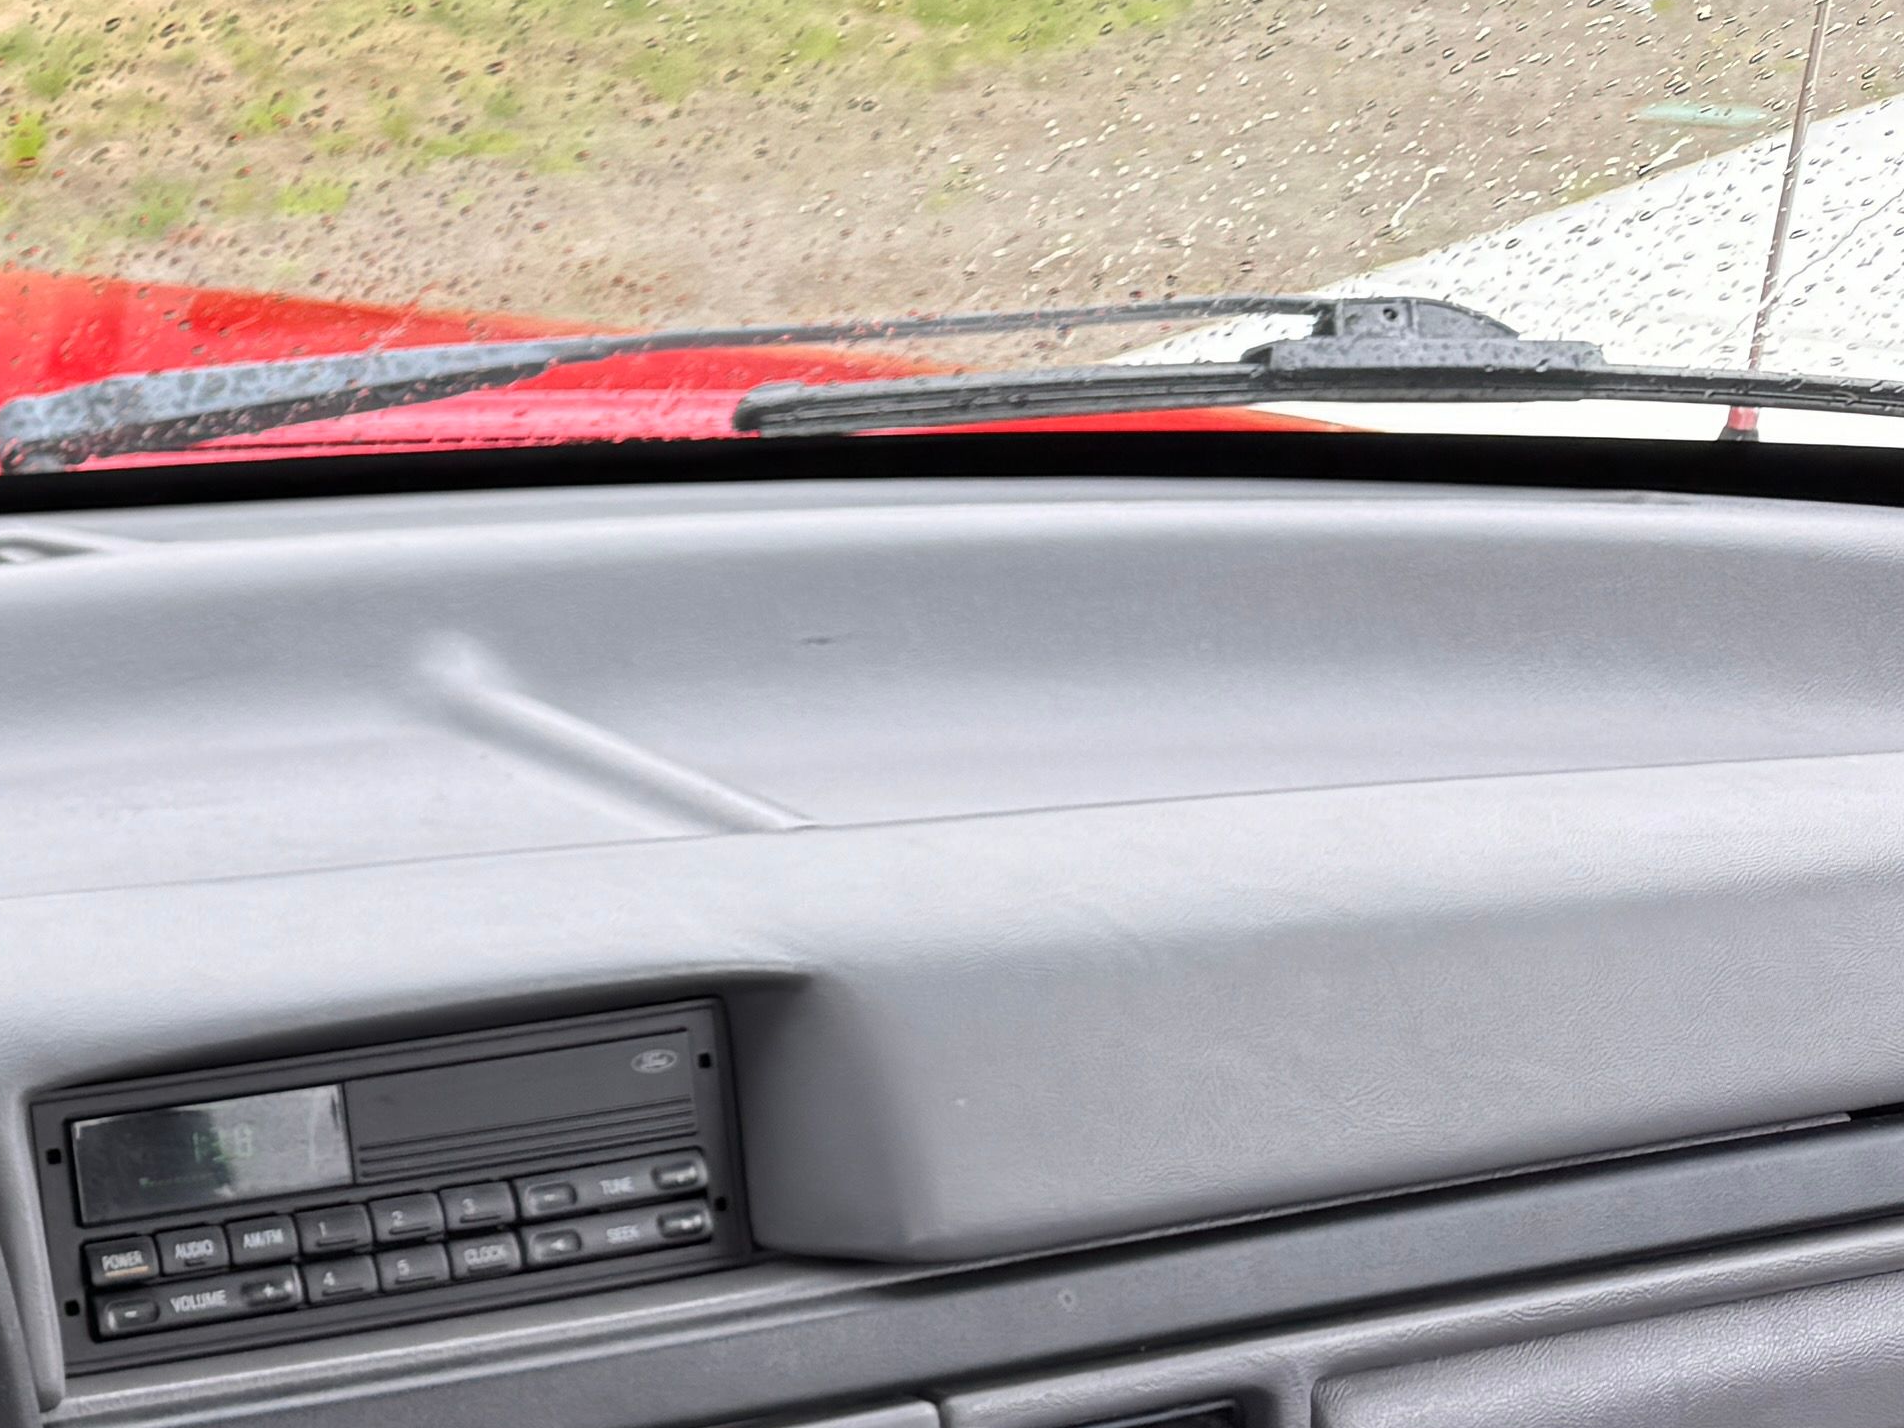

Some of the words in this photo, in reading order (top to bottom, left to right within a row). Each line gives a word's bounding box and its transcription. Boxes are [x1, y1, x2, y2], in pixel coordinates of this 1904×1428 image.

[391, 1210, 403, 1226] 2
[317, 1221, 327, 1237] 1
[175, 1239, 214, 1259] AUDIO
[101, 1251, 143, 1271] POWER
[396, 1259, 410, 1276] 5
[323, 1271, 336, 1286] 4
[170, 1290, 227, 1313] VOLUME
